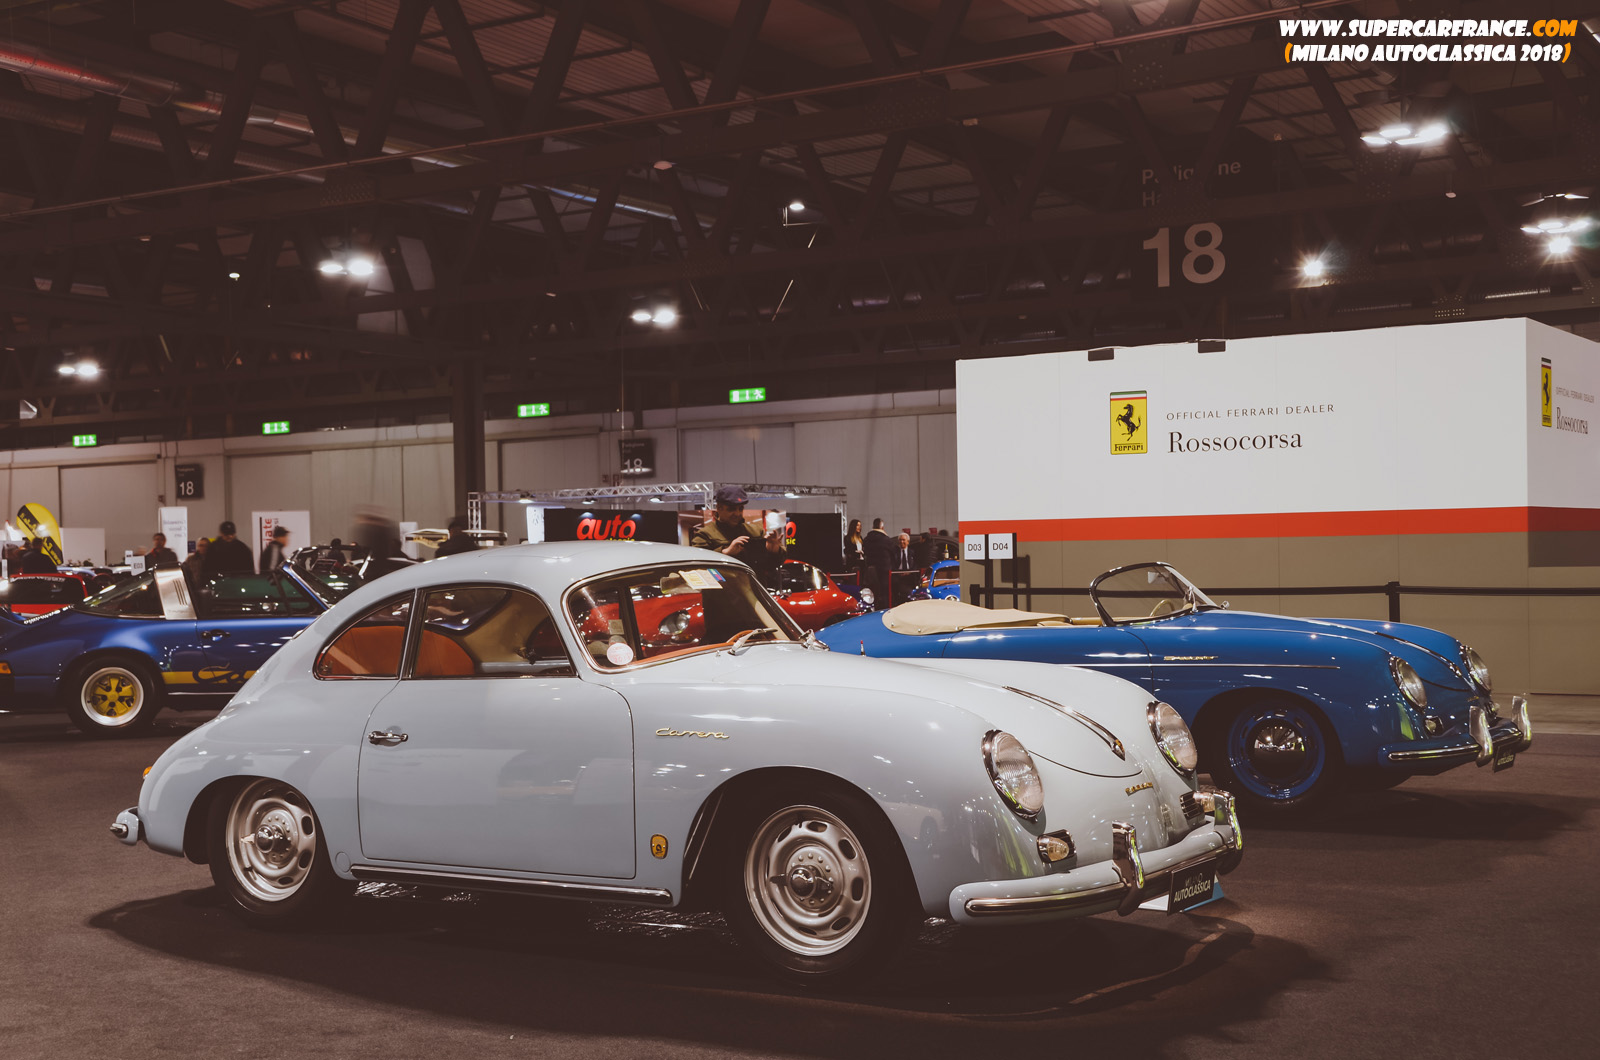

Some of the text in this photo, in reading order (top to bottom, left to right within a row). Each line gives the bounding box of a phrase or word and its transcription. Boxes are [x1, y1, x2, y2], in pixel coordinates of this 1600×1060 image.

[1143, 222, 1226, 287] 18
[1166, 404, 1334, 421] OFFICIAL FERRARI DEALER
[1114, 443, 1144, 452] Ferrari
[1167, 431, 1303, 454] Rossocorsa
[623, 458, 643, 475] 18
[179, 481, 194, 496] 18
[576, 514, 637, 541] auto
[967, 543, 982, 552] D03
[992, 542, 1009, 551] D04
[655, 727, 730, 740] Carrera
[1173, 879, 1211, 903] AUTOCLASSICA
